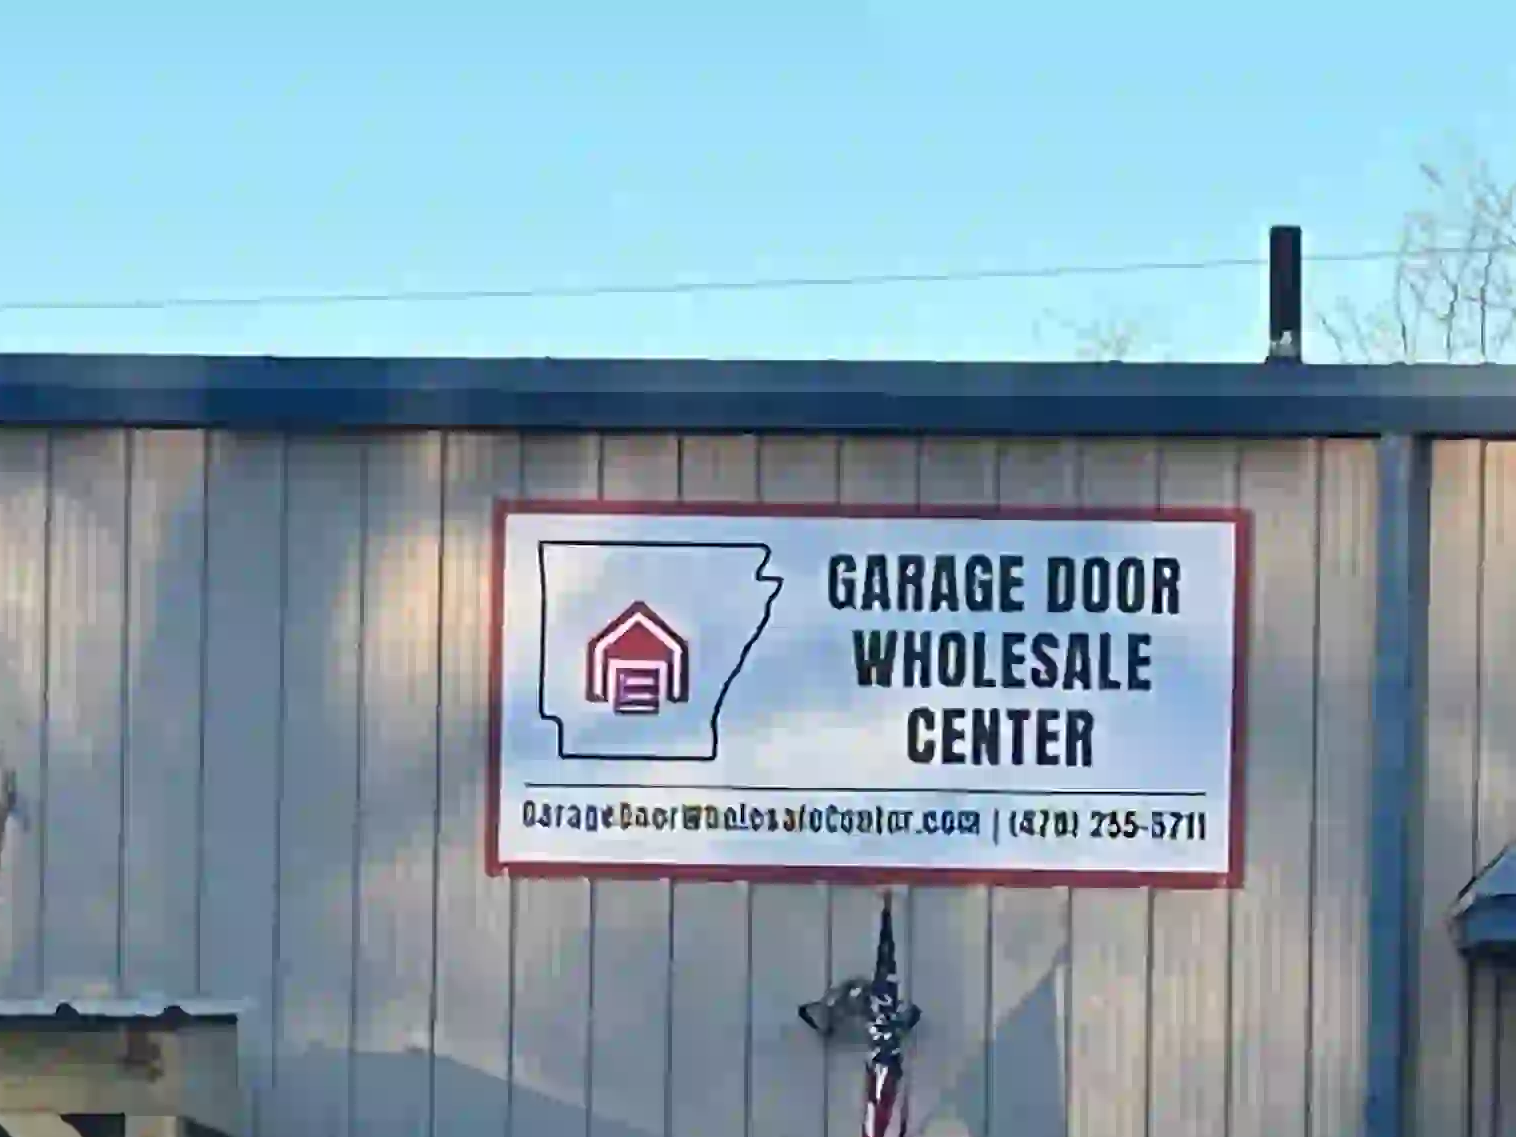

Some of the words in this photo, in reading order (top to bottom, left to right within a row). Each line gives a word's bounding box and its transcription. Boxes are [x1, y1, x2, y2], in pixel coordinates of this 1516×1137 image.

[828, 554, 1025, 613] GARAGE
[1047, 556, 1181, 614] DOOR
[852, 629, 1152, 691] WHOLESALE
[906, 707, 1095, 767] CENTER
